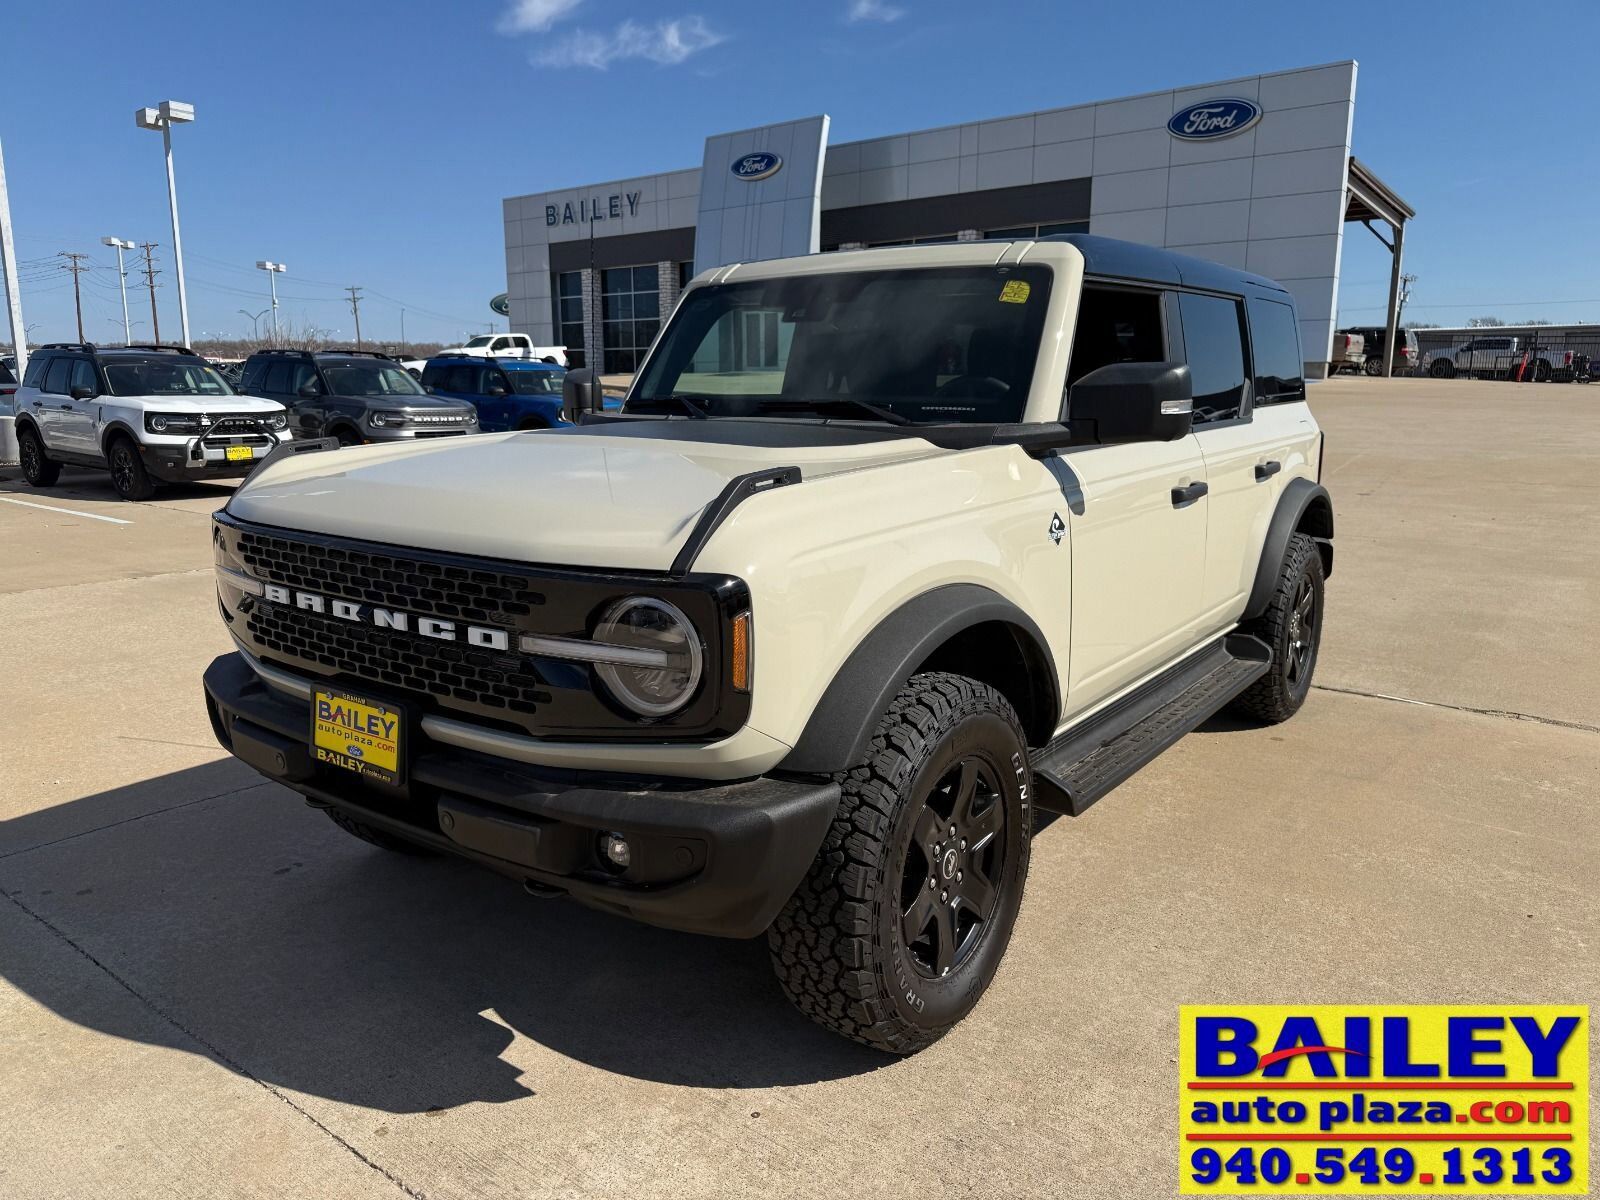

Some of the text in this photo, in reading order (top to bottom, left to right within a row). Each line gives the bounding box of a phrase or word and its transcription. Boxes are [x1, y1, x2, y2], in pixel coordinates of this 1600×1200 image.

[1183, 106, 1238, 133] Ford
[739, 156, 768, 173] Ford
[545, 191, 641, 227] BAILEY
[265, 584, 509, 651] BRONCO
[342, 693, 366, 705] GRAHAM
[318, 700, 396, 739] BAILEY
[317, 748, 365, 773] BAILEY
